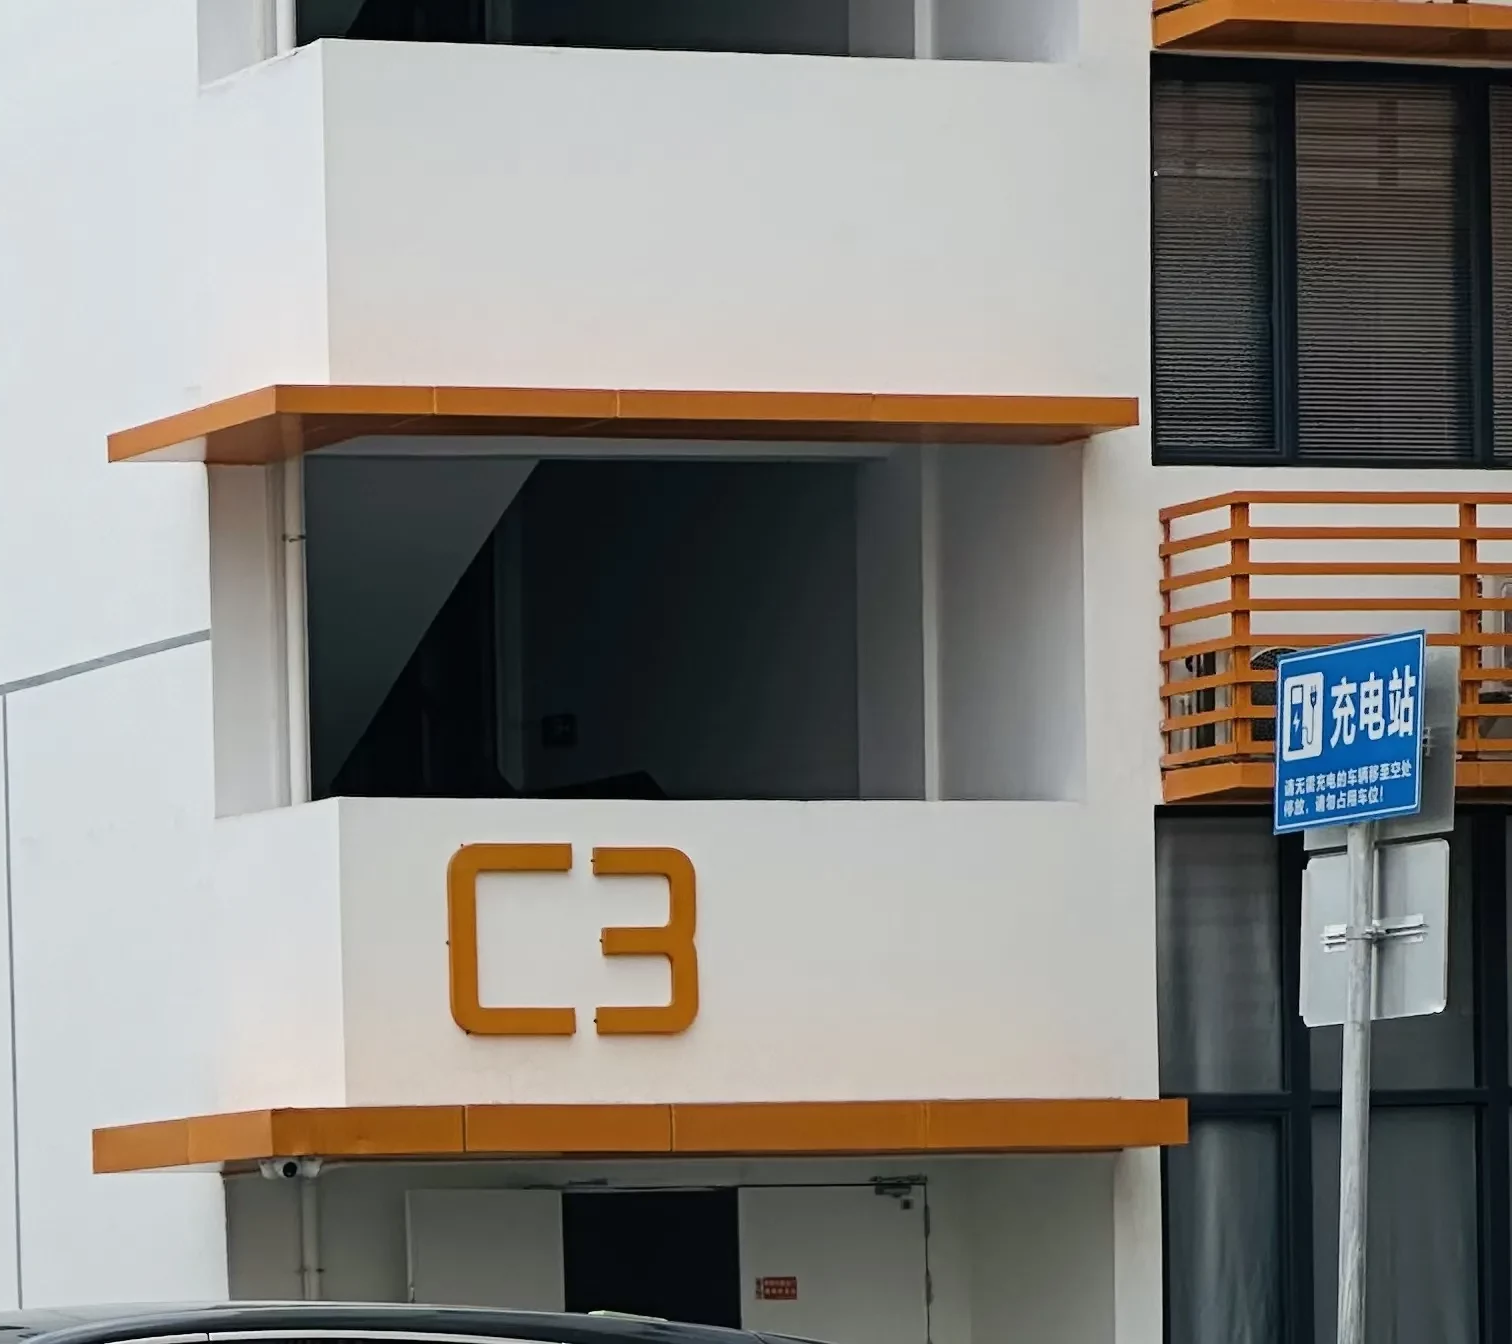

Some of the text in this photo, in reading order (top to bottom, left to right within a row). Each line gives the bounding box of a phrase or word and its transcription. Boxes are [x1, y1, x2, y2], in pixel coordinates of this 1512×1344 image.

[1329, 664, 1417, 749] 充电站
[447, 843, 699, 1036] C3
